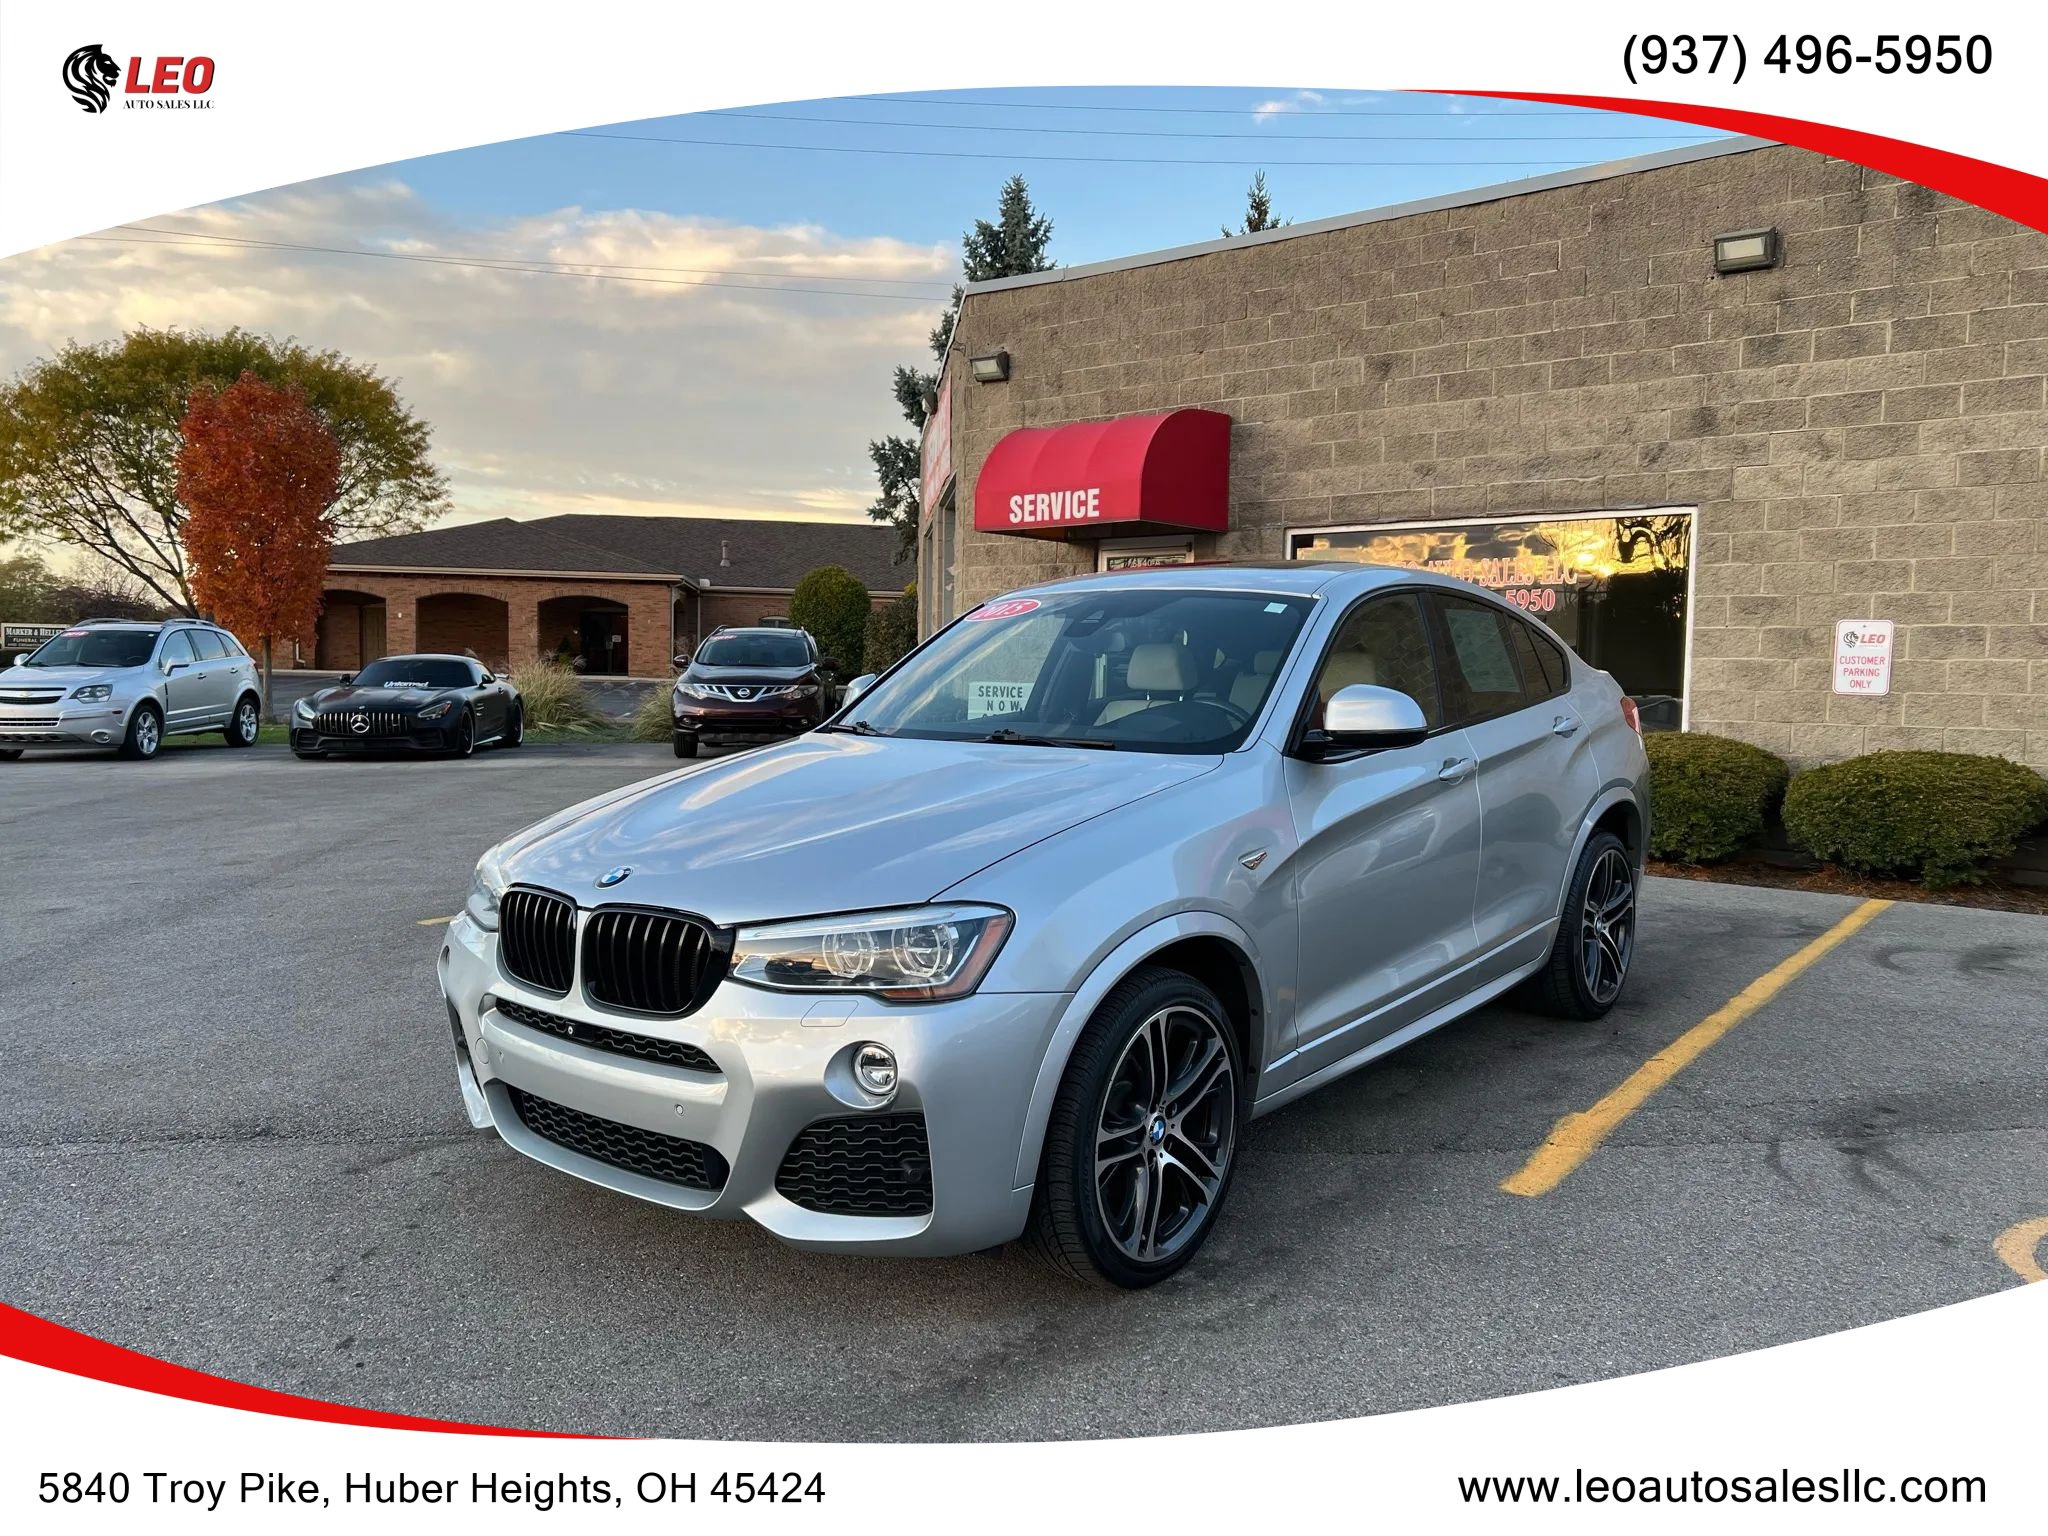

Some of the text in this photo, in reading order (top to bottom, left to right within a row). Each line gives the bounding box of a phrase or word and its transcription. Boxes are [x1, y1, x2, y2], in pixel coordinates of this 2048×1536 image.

[1009, 488, 1100, 524] SERVICE
[1480, 556, 1535, 587] SALES
[1538, 557, 1578, 585] LLC
[1505, 588, 1556, 612] 5950
[6, 627, 33, 636] MARKER
[1859, 633, 1886, 644] LEO
[1839, 655, 1886, 665] CUSTOMER
[1843, 668, 1880, 677] PARKING
[978, 680, 1023, 698] SERVICE
[1849, 679, 1872, 688] ONLY
